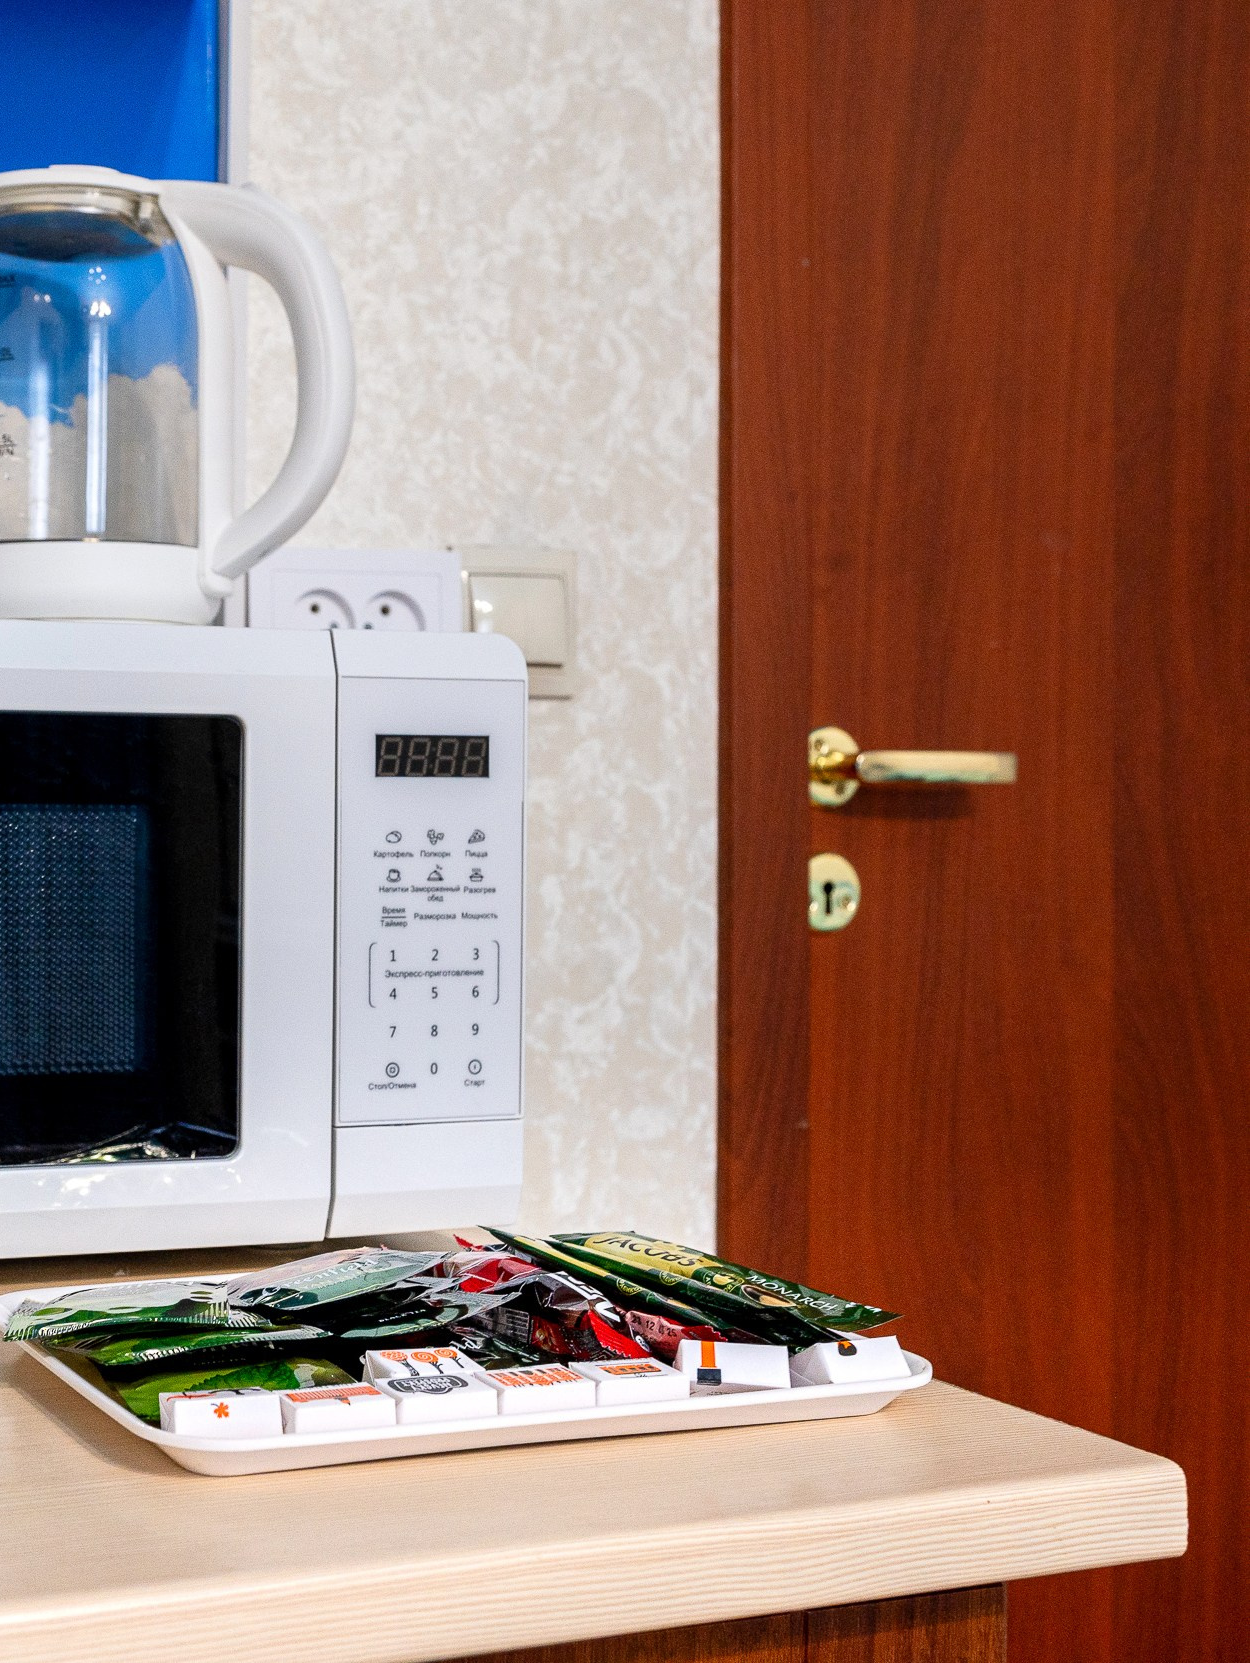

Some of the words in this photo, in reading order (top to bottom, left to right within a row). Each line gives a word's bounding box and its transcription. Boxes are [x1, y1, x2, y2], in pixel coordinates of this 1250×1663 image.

[373, 849, 415, 859] Картофель
[419, 849, 452, 859] Попкорн
[464, 849, 489, 859] Пицца
[378, 885, 409, 893] Напитки
[410, 885, 461, 894] Замороженный
[463, 886, 497, 895] Разогрев
[426, 894, 444, 903] обед
[381, 906, 406, 915] Время
[413, 912, 457, 922] Разморозка
[461, 911, 498, 921] Мощность
[380, 919, 408, 928] Таймер
[389, 949, 397, 962] 1
[430, 948, 440, 962] 2
[472, 947, 481, 961] 3
[384, 969, 485, 980] Экспресс-приготовление
[388, 987, 398, 1000] 4
[430, 986, 439, 999] 5
[471, 985, 480, 999] 6
[388, 1025, 398, 1038] 7
[430, 1024, 439, 1038] 8
[471, 1023, 480, 1036] 9
[429, 1062, 439, 1075] 0
[367, 1081, 417, 1091] Стоп/Отмена
[463, 1078, 486, 1088] Старт
[593, 1236, 699, 1267] JACOBS
[746, 1274, 839, 1311] MONARCH
